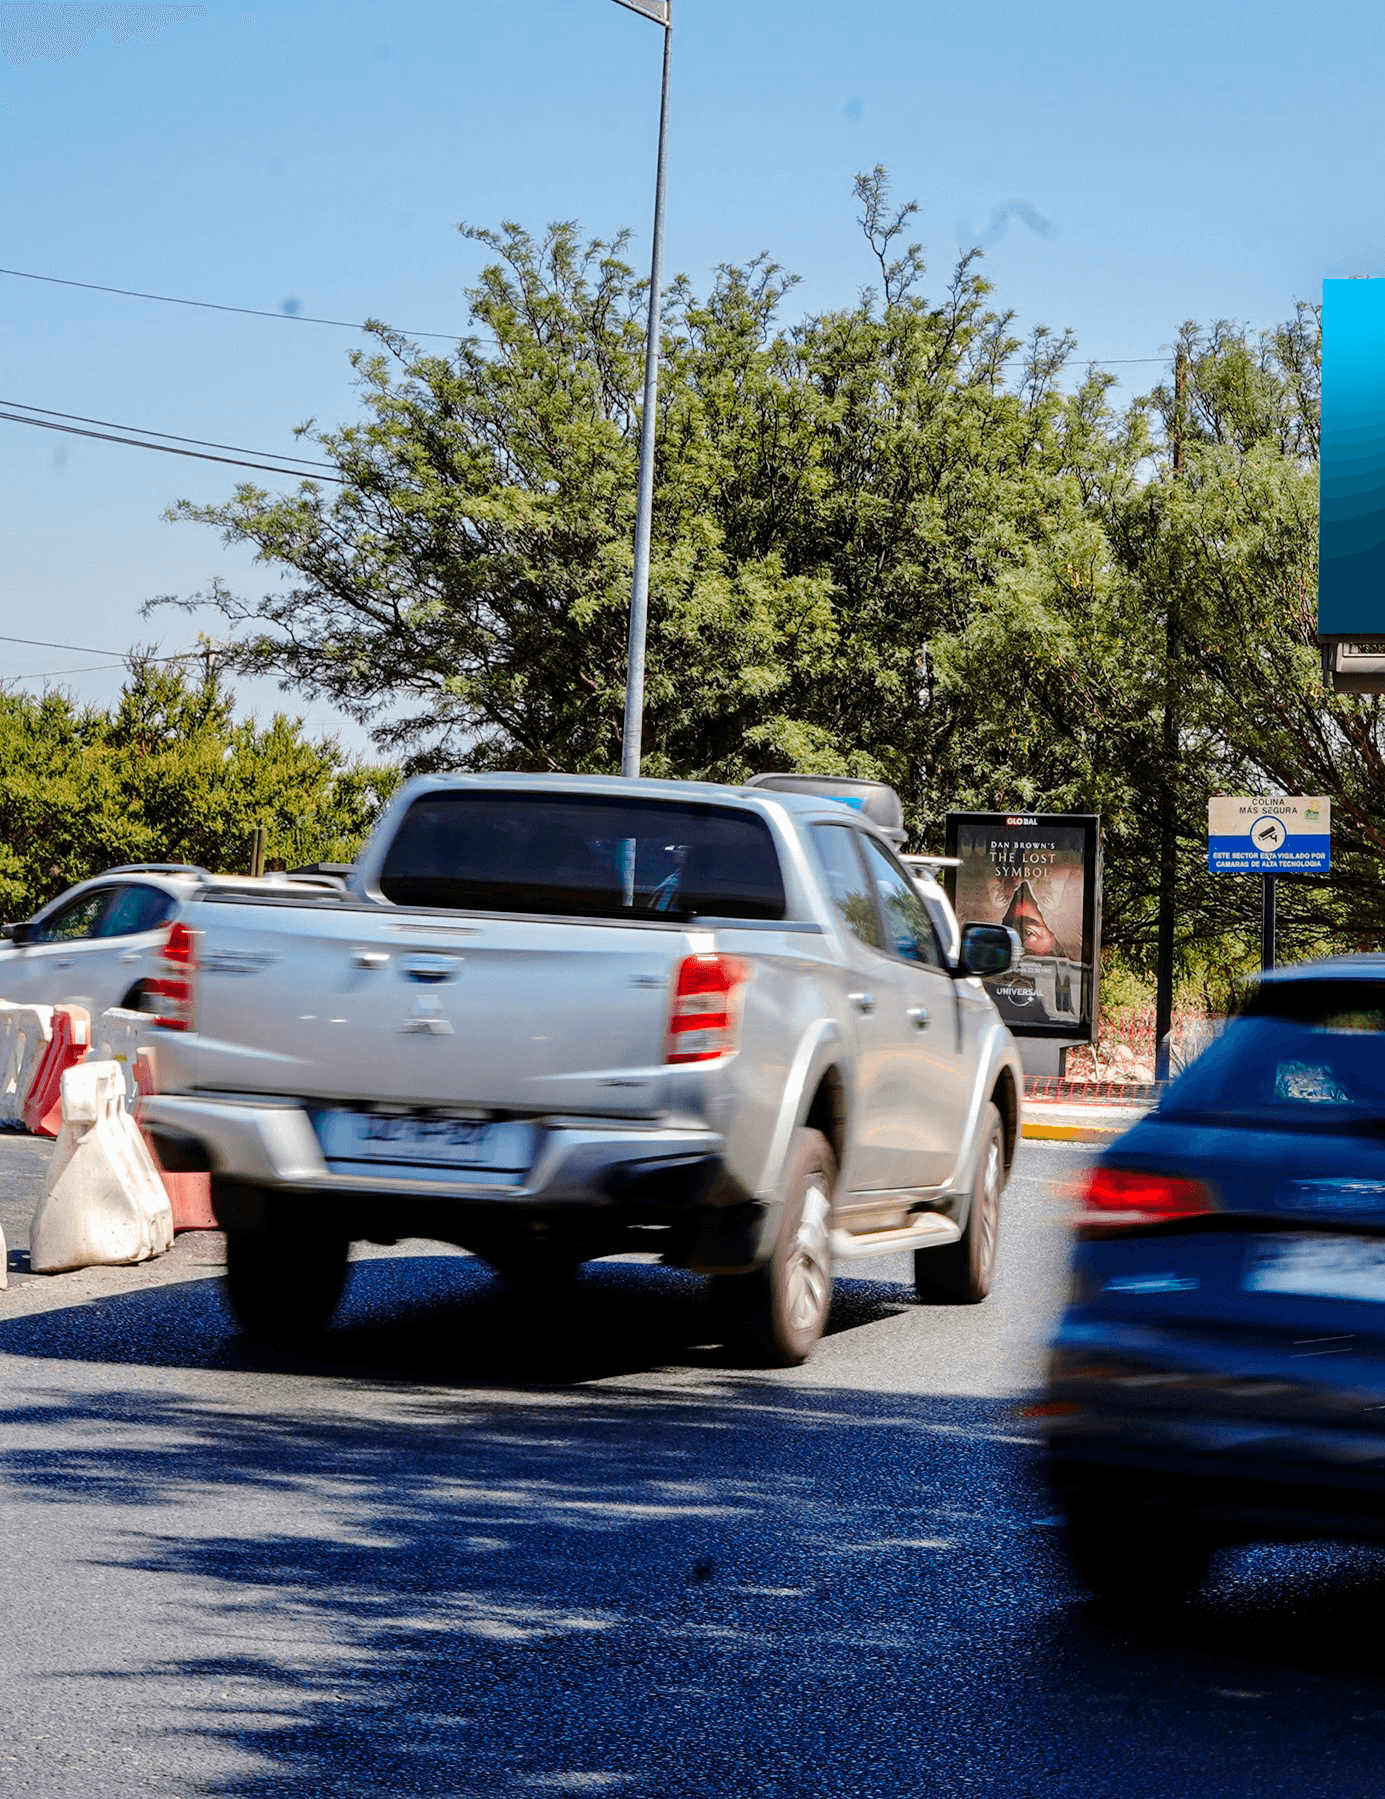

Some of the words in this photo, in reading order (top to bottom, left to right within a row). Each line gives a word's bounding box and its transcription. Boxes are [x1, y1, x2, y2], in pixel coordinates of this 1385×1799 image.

[1251, 798, 1285, 806] COLINA
[1239, 805, 1258, 814] MÁS
[1007, 817, 1038, 826] GLOBAL
[989, 852, 1015, 863] THE
[1022, 853, 1056, 864] LOST
[1311, 852, 1326, 860] POR
[995, 866, 1049, 878] SYMBOL
[996, 987, 1044, 997] UNIVERSAL
